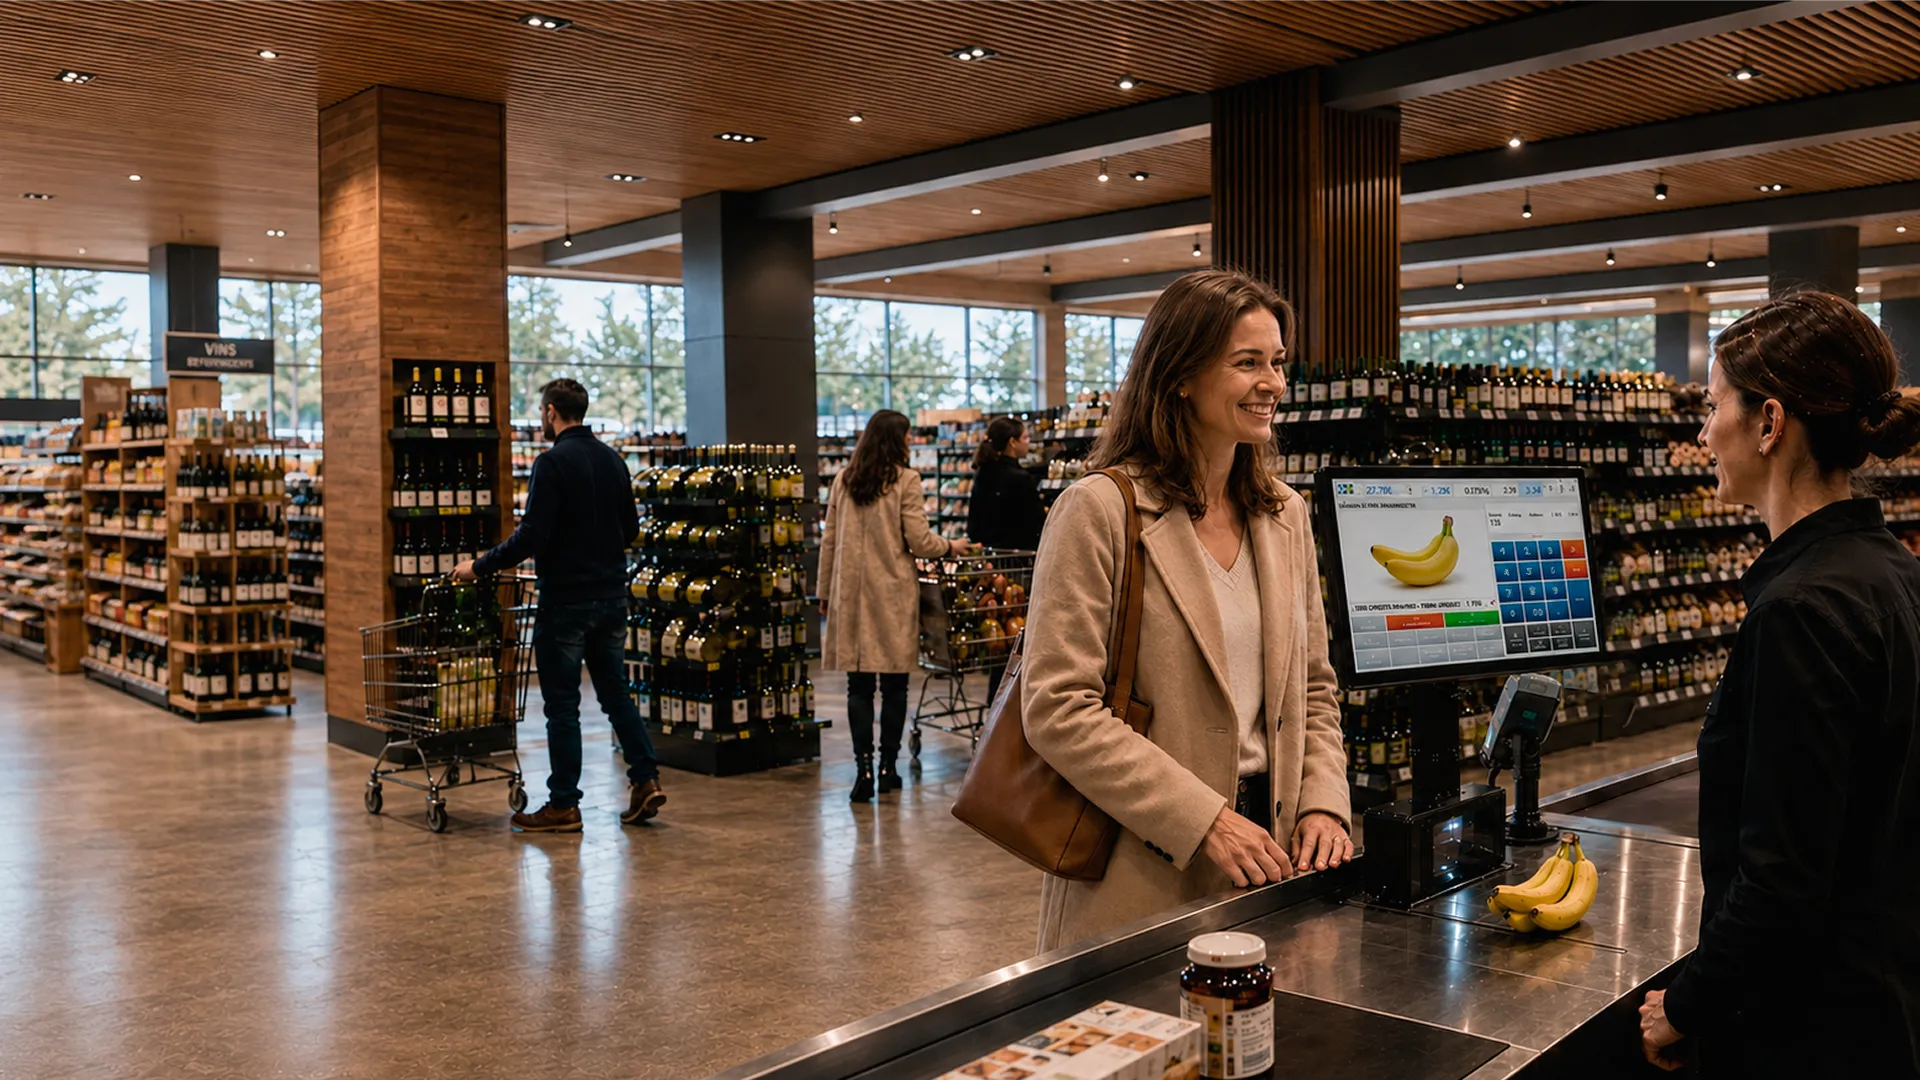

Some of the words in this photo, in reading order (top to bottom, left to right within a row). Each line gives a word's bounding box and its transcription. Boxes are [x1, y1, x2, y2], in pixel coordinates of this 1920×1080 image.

[205, 342, 237, 356] VINS
[1523, 546, 1531, 555] 2
[1525, 567, 1532, 576] 5
[1505, 588, 1512, 598] 7
